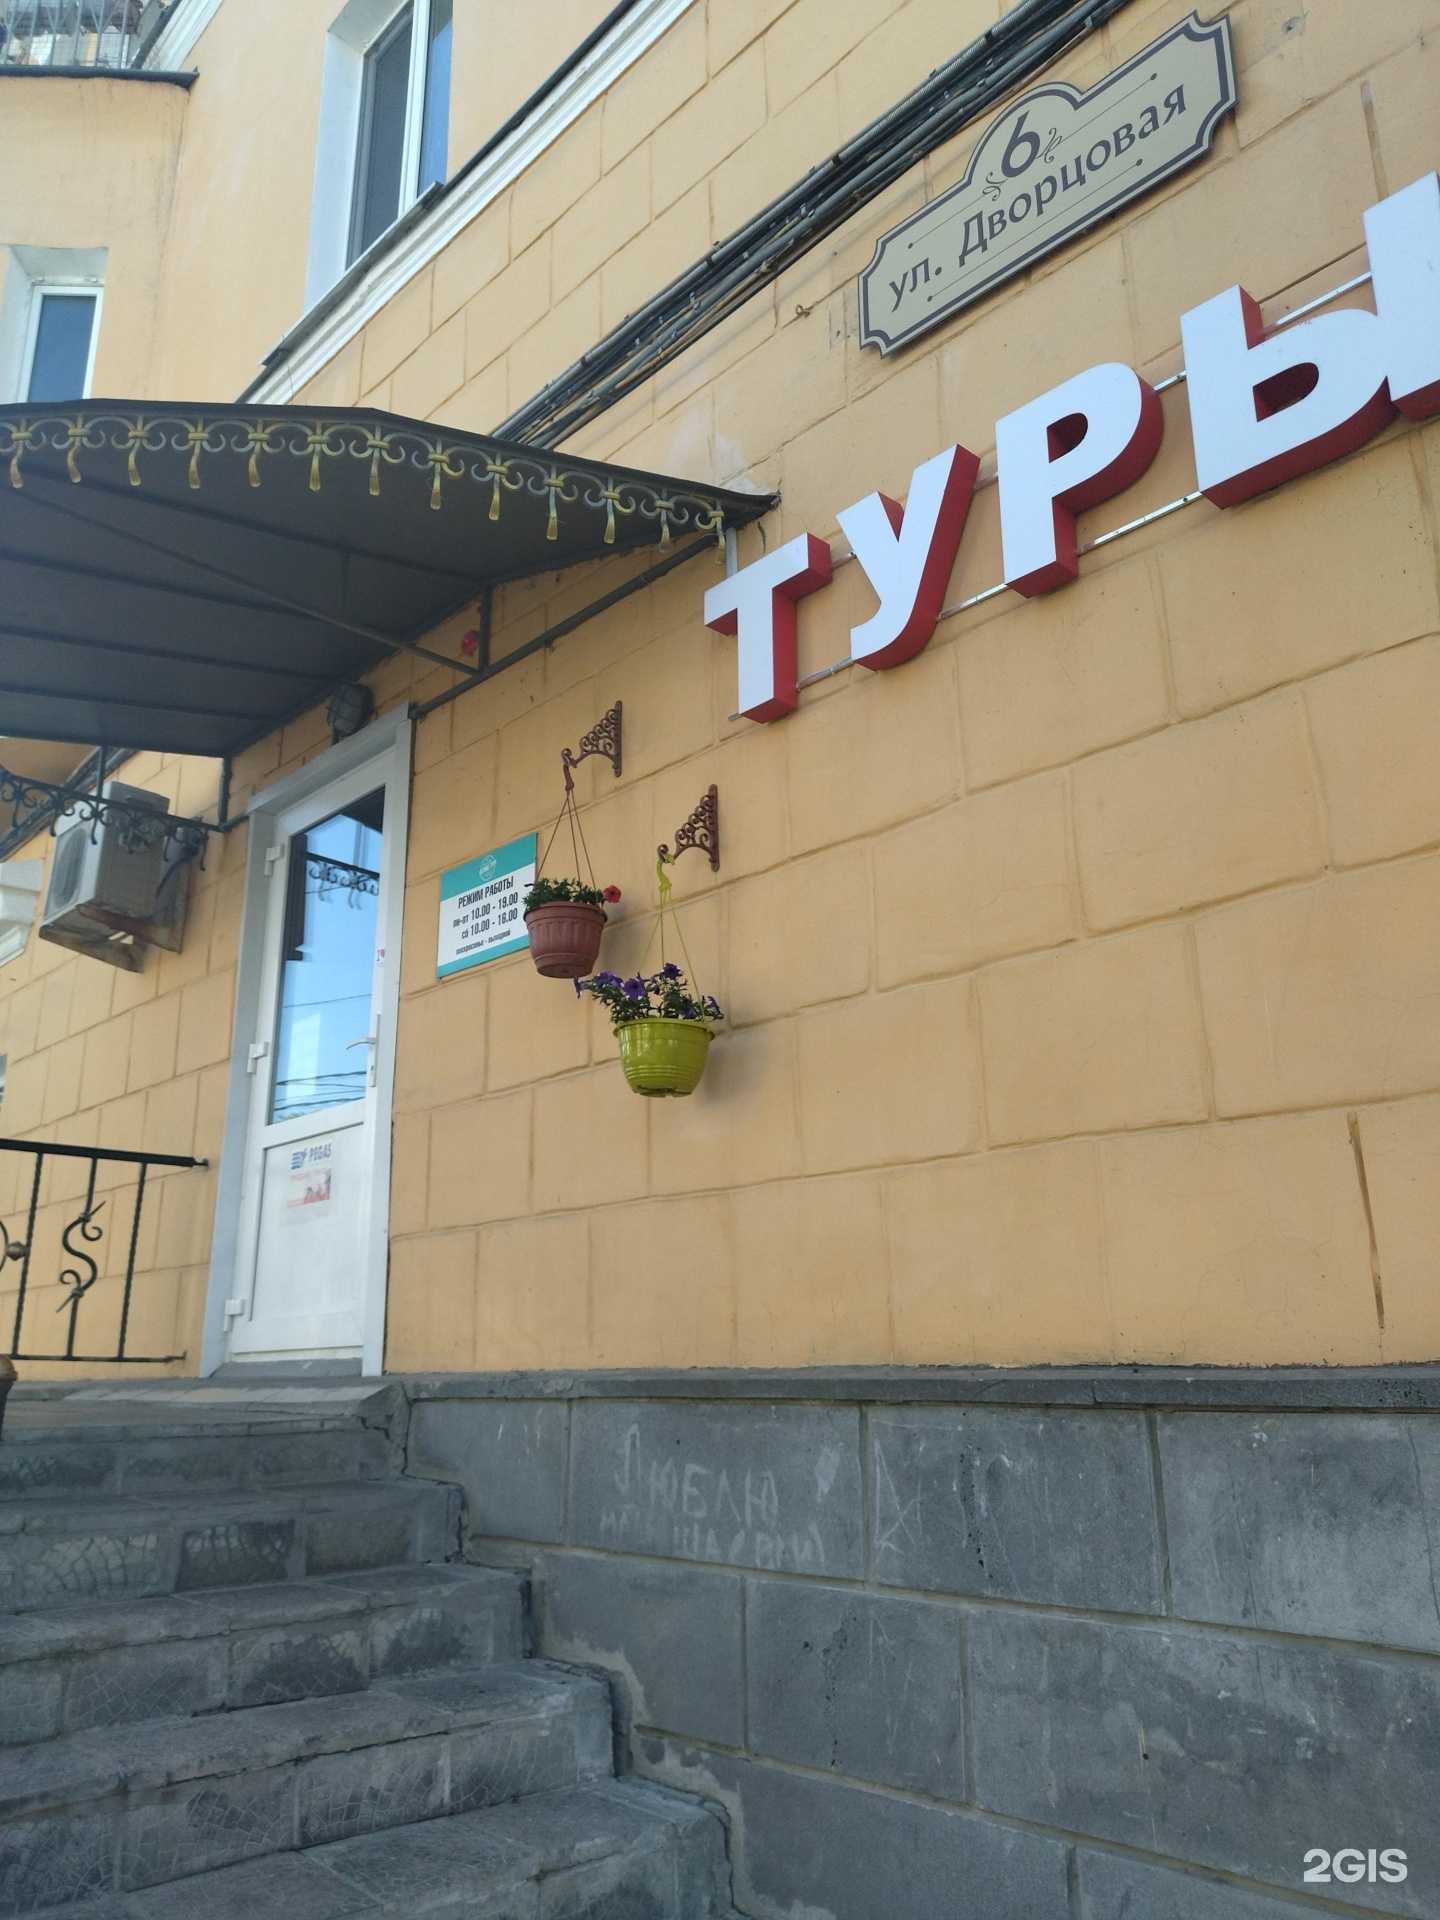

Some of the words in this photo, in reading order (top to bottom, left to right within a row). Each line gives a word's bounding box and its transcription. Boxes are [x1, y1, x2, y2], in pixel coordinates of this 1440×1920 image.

[1001, 110, 1041, 178] 6
[889, 257, 942, 312] ул.
[958, 84, 1187, 266] Дворцовая
[703, 171, 1440, 724] ТУРЫ
[458, 888, 484, 909] РЕЖИМ
[484, 876, 514, 898] РАБОТЫ
[471, 903, 491, 921] 10.00
[498, 891, 519, 910] 19.00
[470, 918, 490, 936] 10.00
